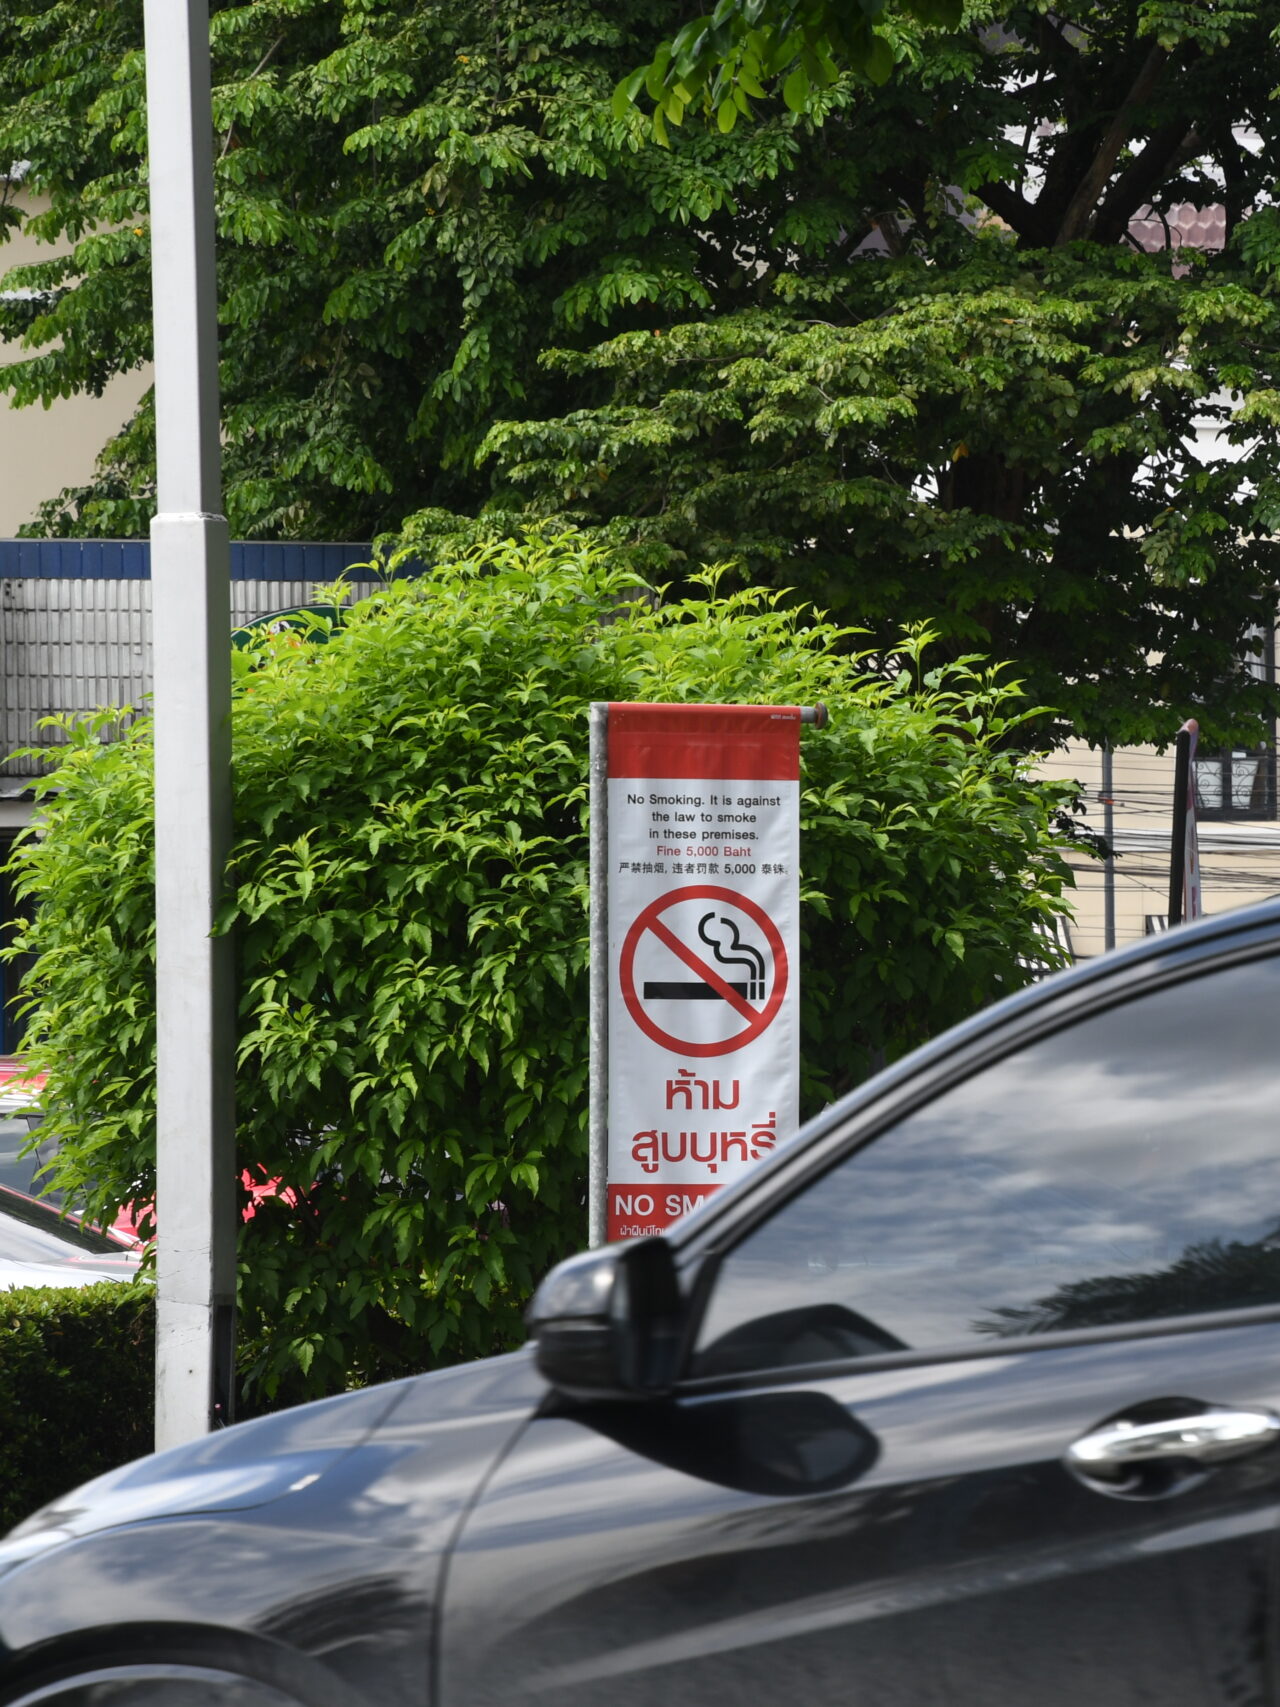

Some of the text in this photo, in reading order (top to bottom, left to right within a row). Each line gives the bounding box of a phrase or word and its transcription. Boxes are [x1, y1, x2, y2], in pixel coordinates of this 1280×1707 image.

[627, 794, 781, 808] No Smoking. It is against
[652, 811, 757, 823] the law to smoke
[649, 828, 759, 842] in these premises.
[656, 845, 752, 858] Fine 5,000 Baht
[724, 863, 756, 875] 5,000
[665, 1068, 740, 1110] ห้าม
[631, 1111, 777, 1174] สูบบุหรี่
[615, 1194, 654, 1216] NO
